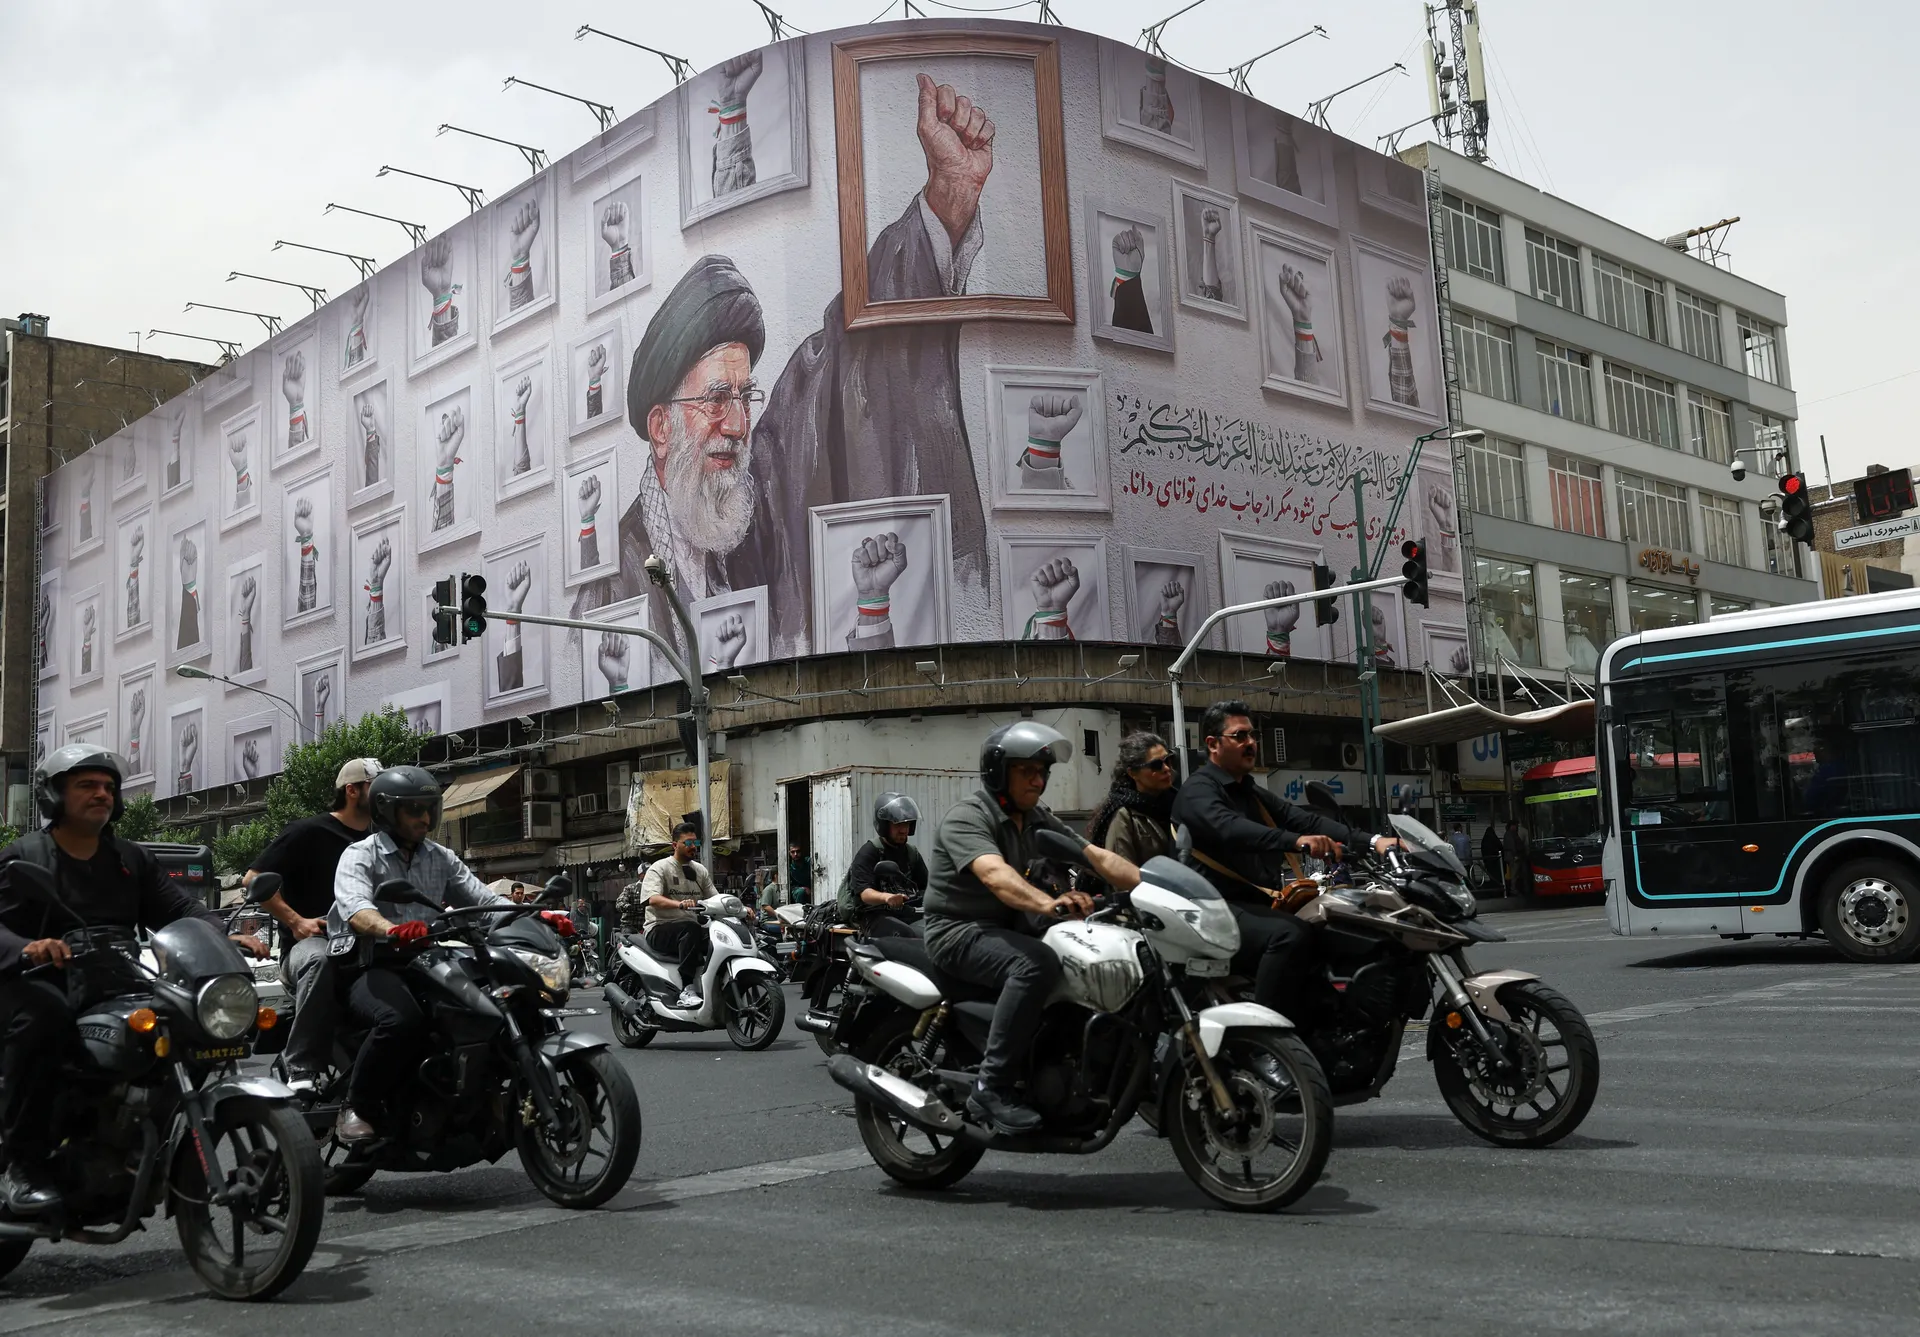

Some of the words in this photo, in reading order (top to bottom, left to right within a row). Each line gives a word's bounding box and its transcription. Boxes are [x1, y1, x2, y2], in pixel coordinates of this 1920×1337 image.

[1195, 481, 1228, 514] خدای
[1229, 489, 1263, 525] جانب
[1262, 494, 1274, 518] از
[1273, 486, 1294, 522] مگر
[1293, 496, 1315, 524] نشود
[1311, 492, 1340, 536] کسی
[1840, 529, 1873, 544] اسلامی
[1874, 523, 1910, 537] جمهوری
